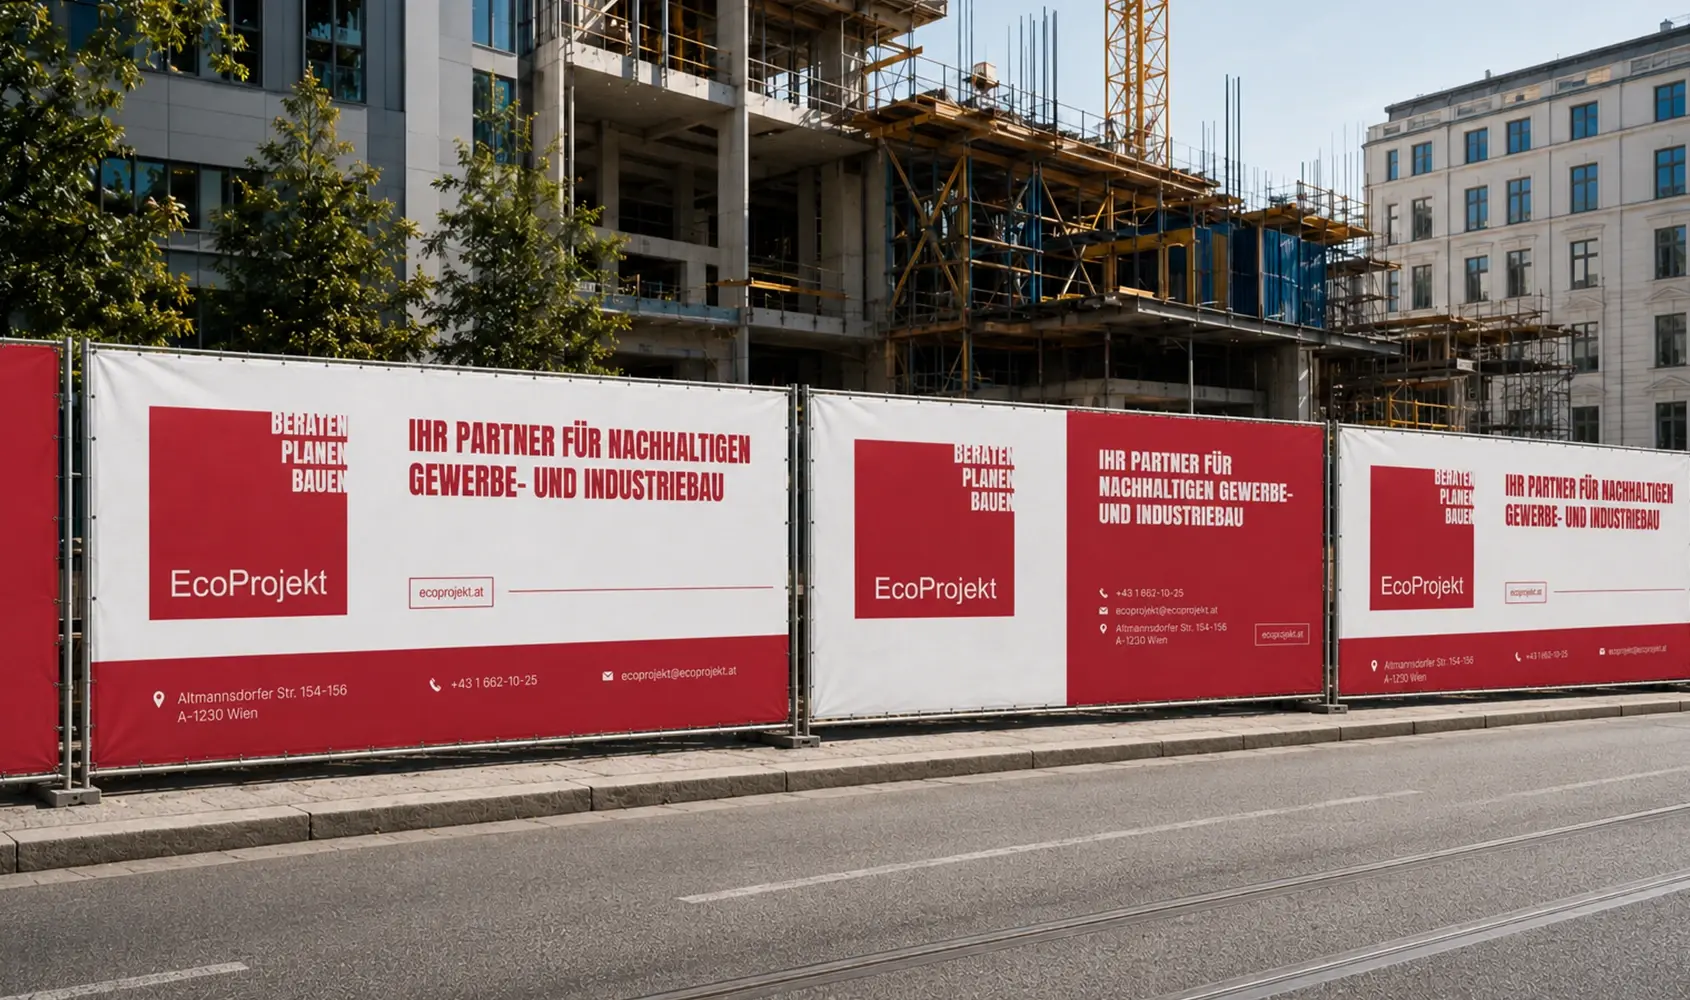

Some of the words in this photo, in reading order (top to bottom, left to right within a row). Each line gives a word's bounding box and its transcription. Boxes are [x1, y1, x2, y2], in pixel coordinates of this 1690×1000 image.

[271, 412, 348, 437] BERATEN
[281, 440, 348, 465] PLANEN
[409, 418, 448, 453] IHR
[456, 420, 555, 457] PARTNER
[562, 420, 602, 459] FÜR
[608, 428, 751, 465] NACHHALTIGEN
[954, 444, 1015, 466] BERATEN
[1099, 449, 1126, 471] IHR
[1131, 450, 1200, 474] PARTNER
[1204, 450, 1233, 475] FÜR
[292, 468, 348, 493] BAUEN
[409, 462, 527, 498] GEWERBE-
[534, 466, 577, 499] UND
[584, 467, 724, 502] INDUSTRIEBAU
[962, 467, 1015, 489] PLANEN
[1099, 476, 1214, 500] NACHHALTIGEN
[1219, 480, 1294, 503] GEWERBE-
[1505, 474, 1525, 497] IHR
[1528, 474, 1576, 500] PARTNER
[1579, 474, 1599, 501] FÜR
[1602, 479, 1674, 504] NACHHALTIGEN
[971, 491, 1015, 512] BAUEN
[1099, 503, 1131, 525] UND
[1136, 504, 1244, 528] INDUSTRIEBAU
[1505, 503, 1563, 528] GEWERBE-
[1565, 506, 1587, 529] UND
[1590, 507, 1660, 531] INDUSTRIEBAU
[171, 568, 327, 603] EcoProjekt
[419, 585, 485, 600] ecoprojekt.at
[875, 576, 997, 605] EcoProjekt
[1381, 575, 1464, 600] EcoProjekt
[1147, 636, 1168, 645] Wien
[451, 678, 473, 689] +43
[475, 677, 480, 688] 1
[483, 674, 538, 688] 662-10-25
[621, 666, 737, 682] ecoprojekt@ecoprojekt.at
[177, 685, 274, 705] Altmannsdorfer
[276, 686, 297, 699] Str.
[300, 683, 348, 698] 154-156
[177, 708, 224, 723] A-1230
[227, 707, 258, 720] Wien
